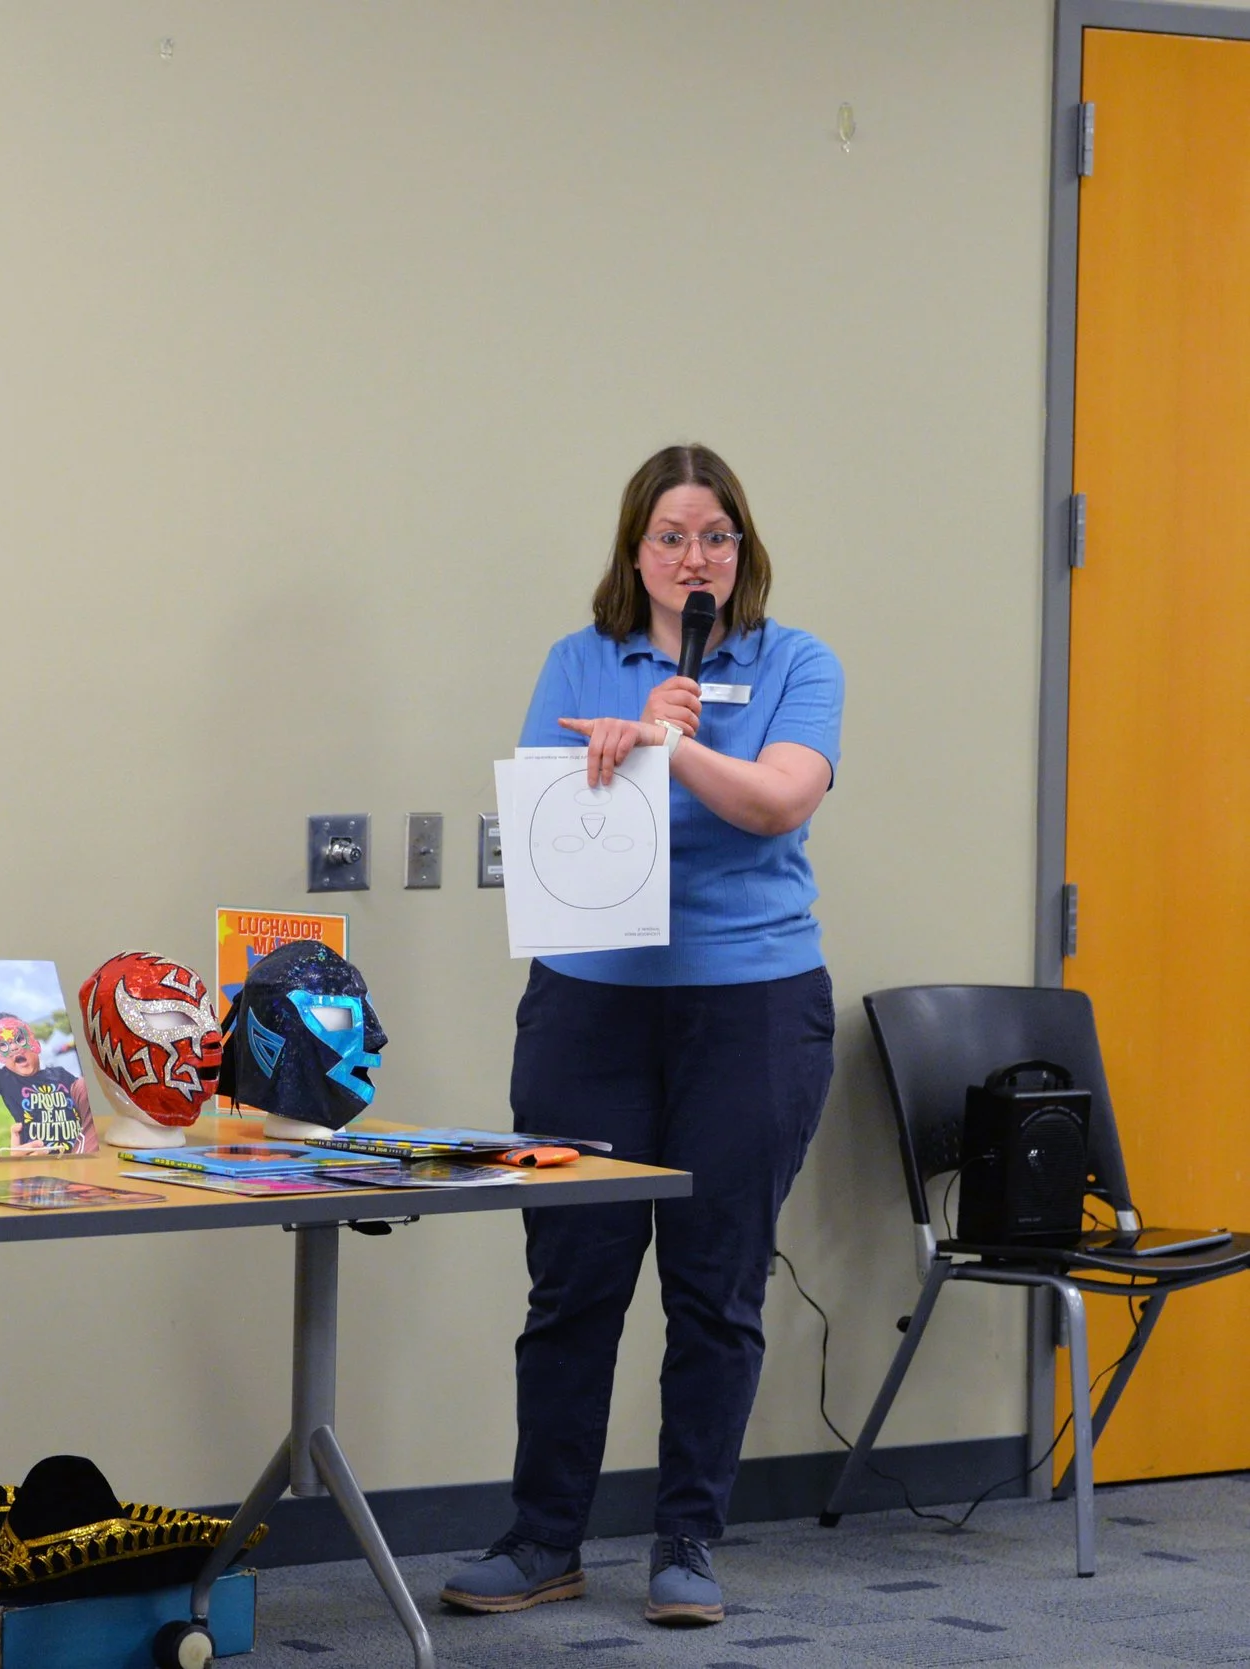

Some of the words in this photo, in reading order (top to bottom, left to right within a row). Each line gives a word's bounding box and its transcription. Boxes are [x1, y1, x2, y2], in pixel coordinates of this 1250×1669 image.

[238, 916, 323, 940] LUCHADOR
[253, 936, 293, 956] MA
[30, 1092, 68, 1110] PROUD
[41, 1110, 54, 1123] DE
[54, 1109, 67, 1122] MI
[29, 1120, 82, 1141] CULTURA
